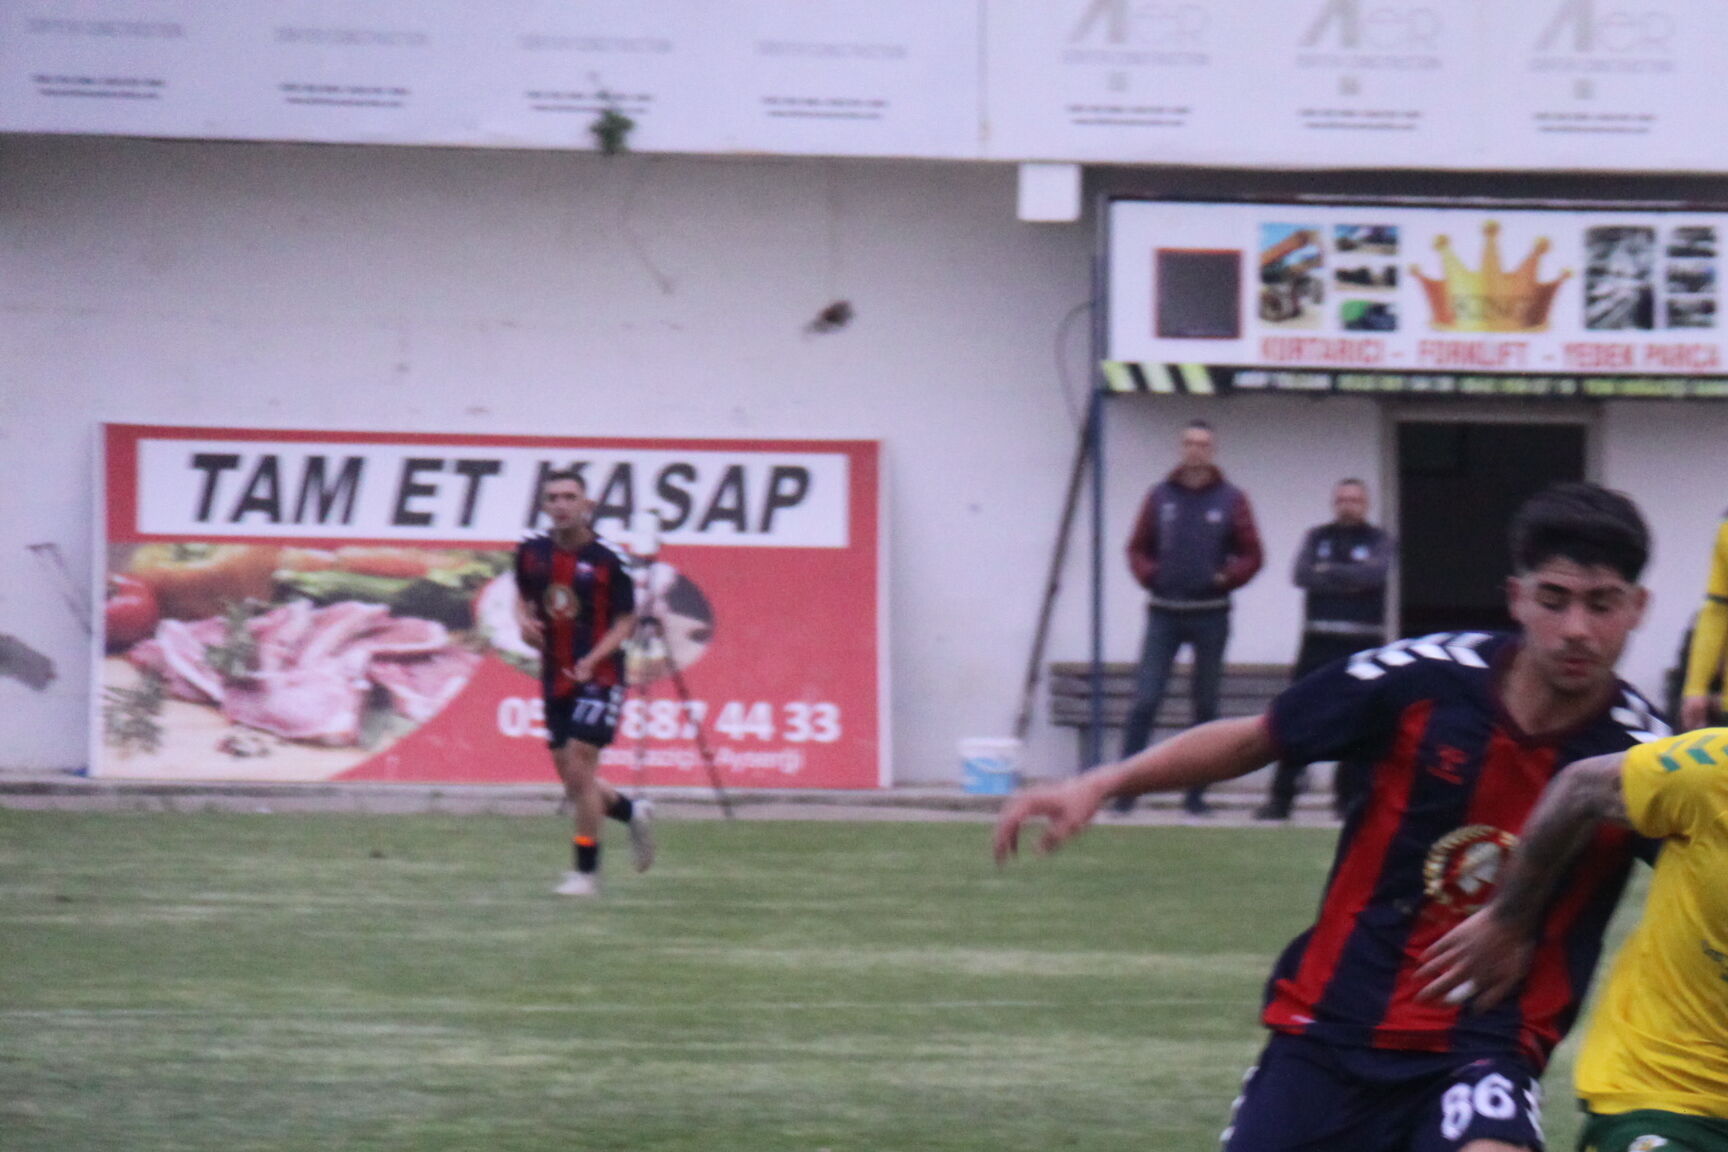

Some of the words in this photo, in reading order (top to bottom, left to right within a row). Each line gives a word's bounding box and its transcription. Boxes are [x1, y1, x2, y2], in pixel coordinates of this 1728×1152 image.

[189, 453, 364, 527] TAM
[390, 457, 501, 529] ET
[714, 701, 775, 741] 44
[783, 702, 841, 743] 33
